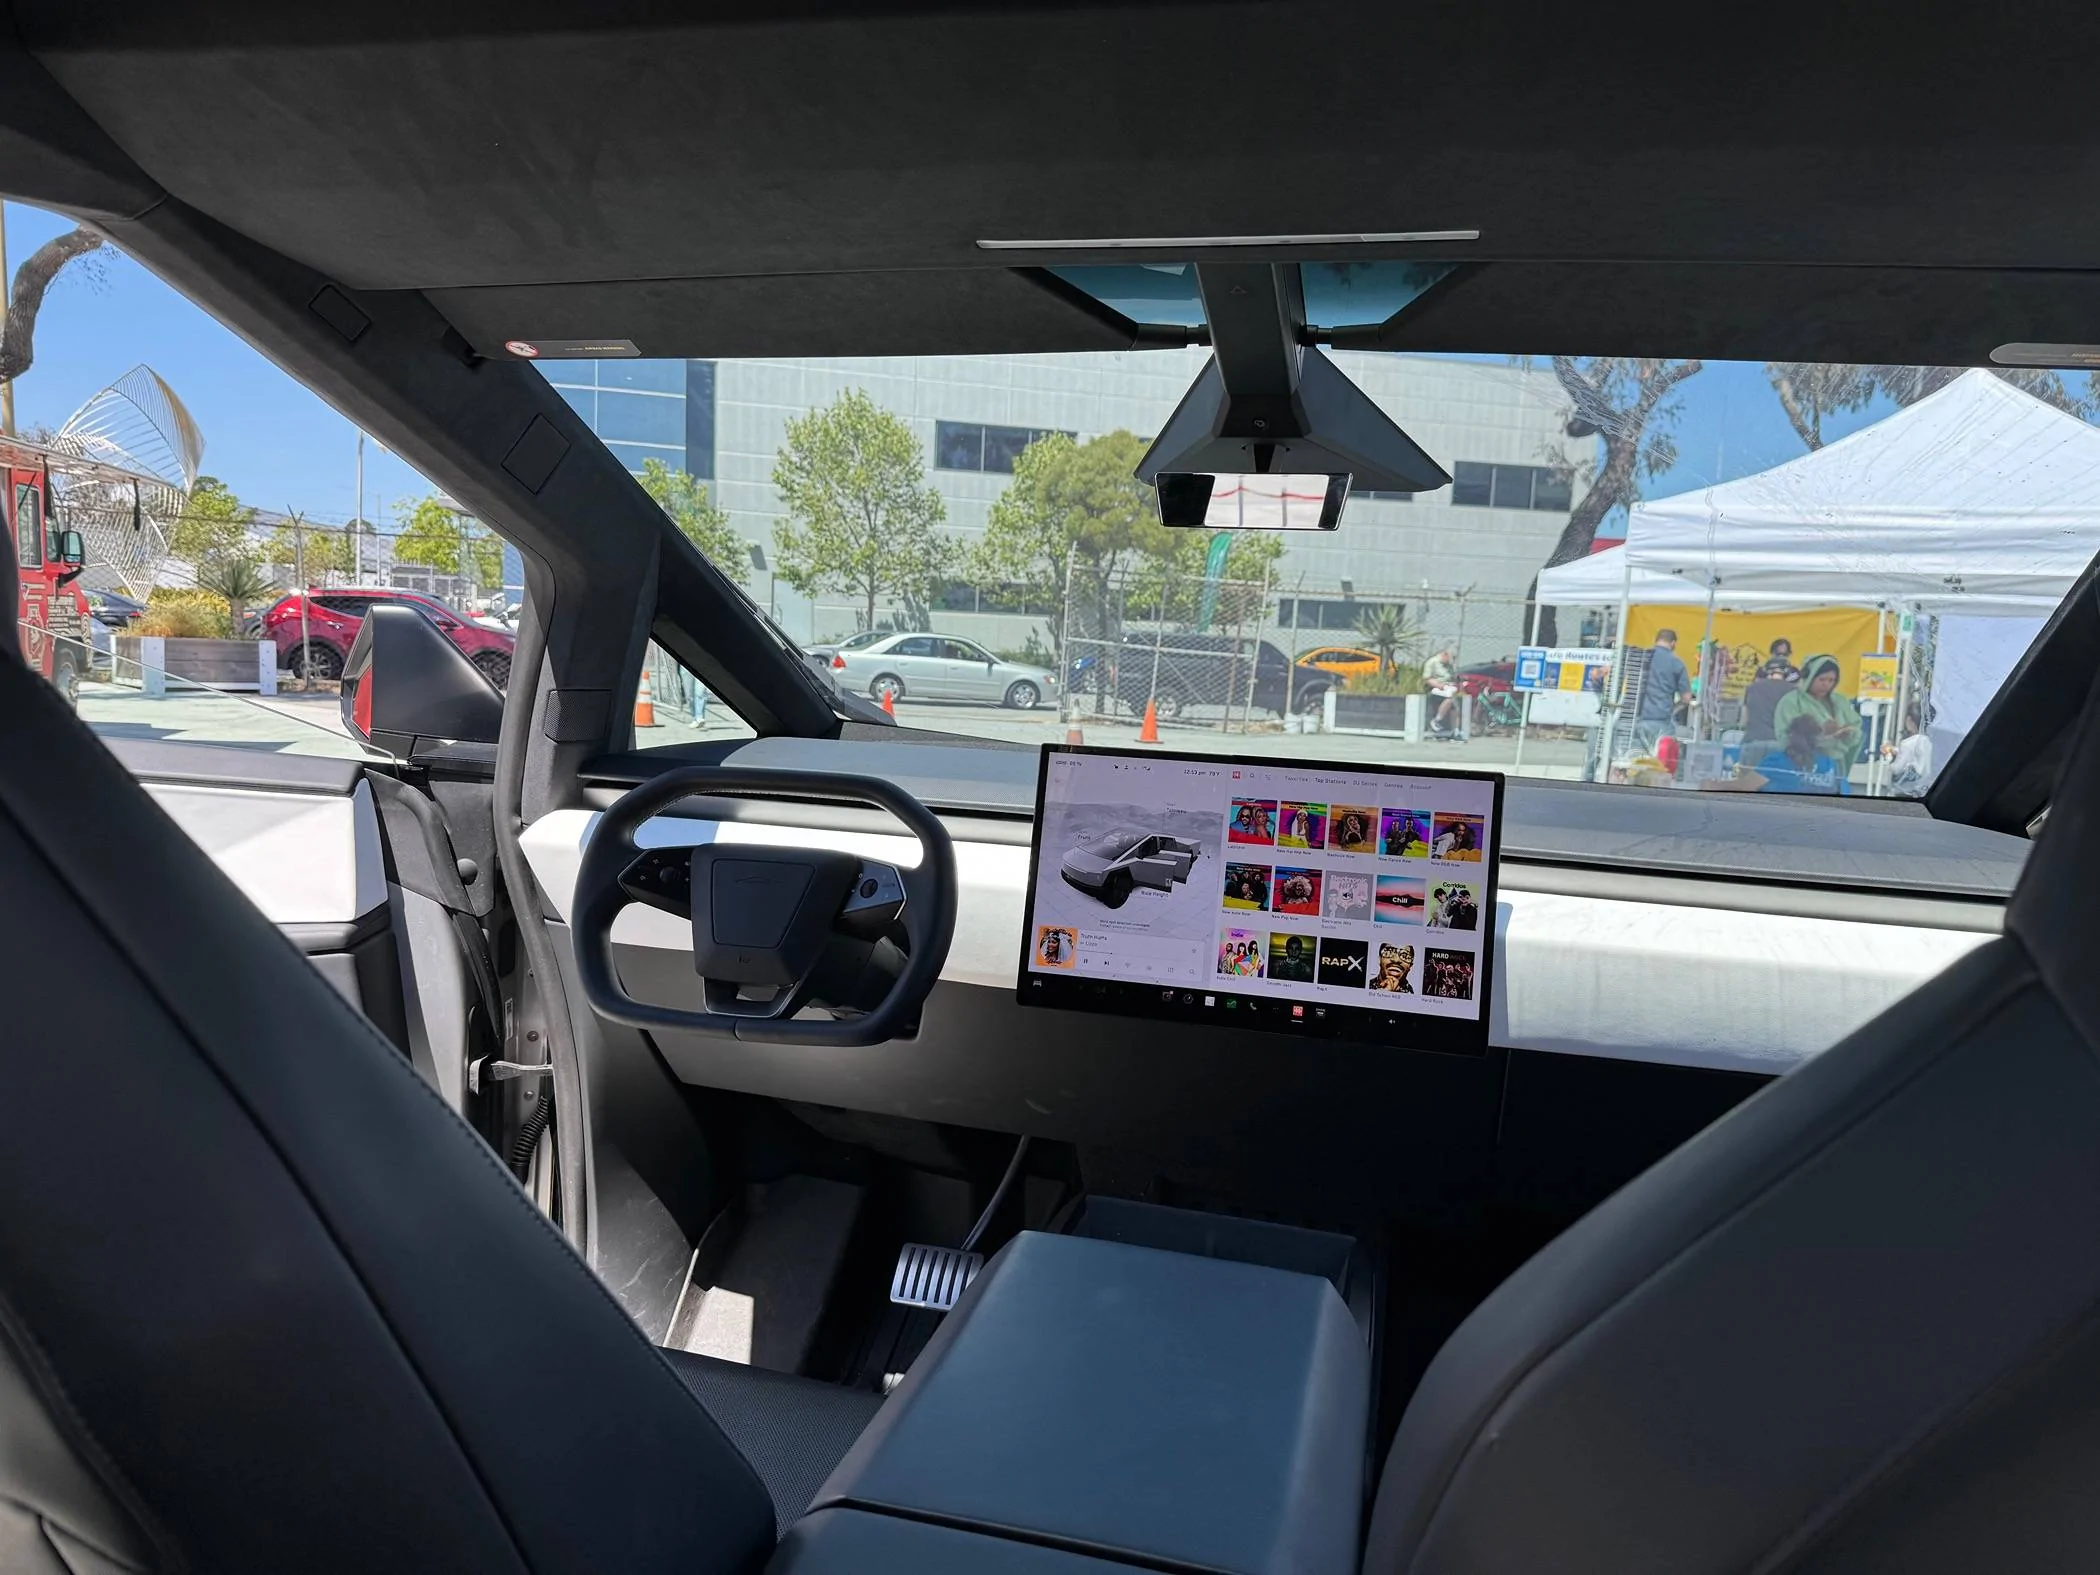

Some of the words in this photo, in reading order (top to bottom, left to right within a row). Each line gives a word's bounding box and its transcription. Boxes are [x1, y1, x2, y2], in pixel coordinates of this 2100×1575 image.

[1442, 881, 1467, 889] Corridos
[1392, 896, 1408, 904] Chill
[1432, 952, 1449, 960] HARD
